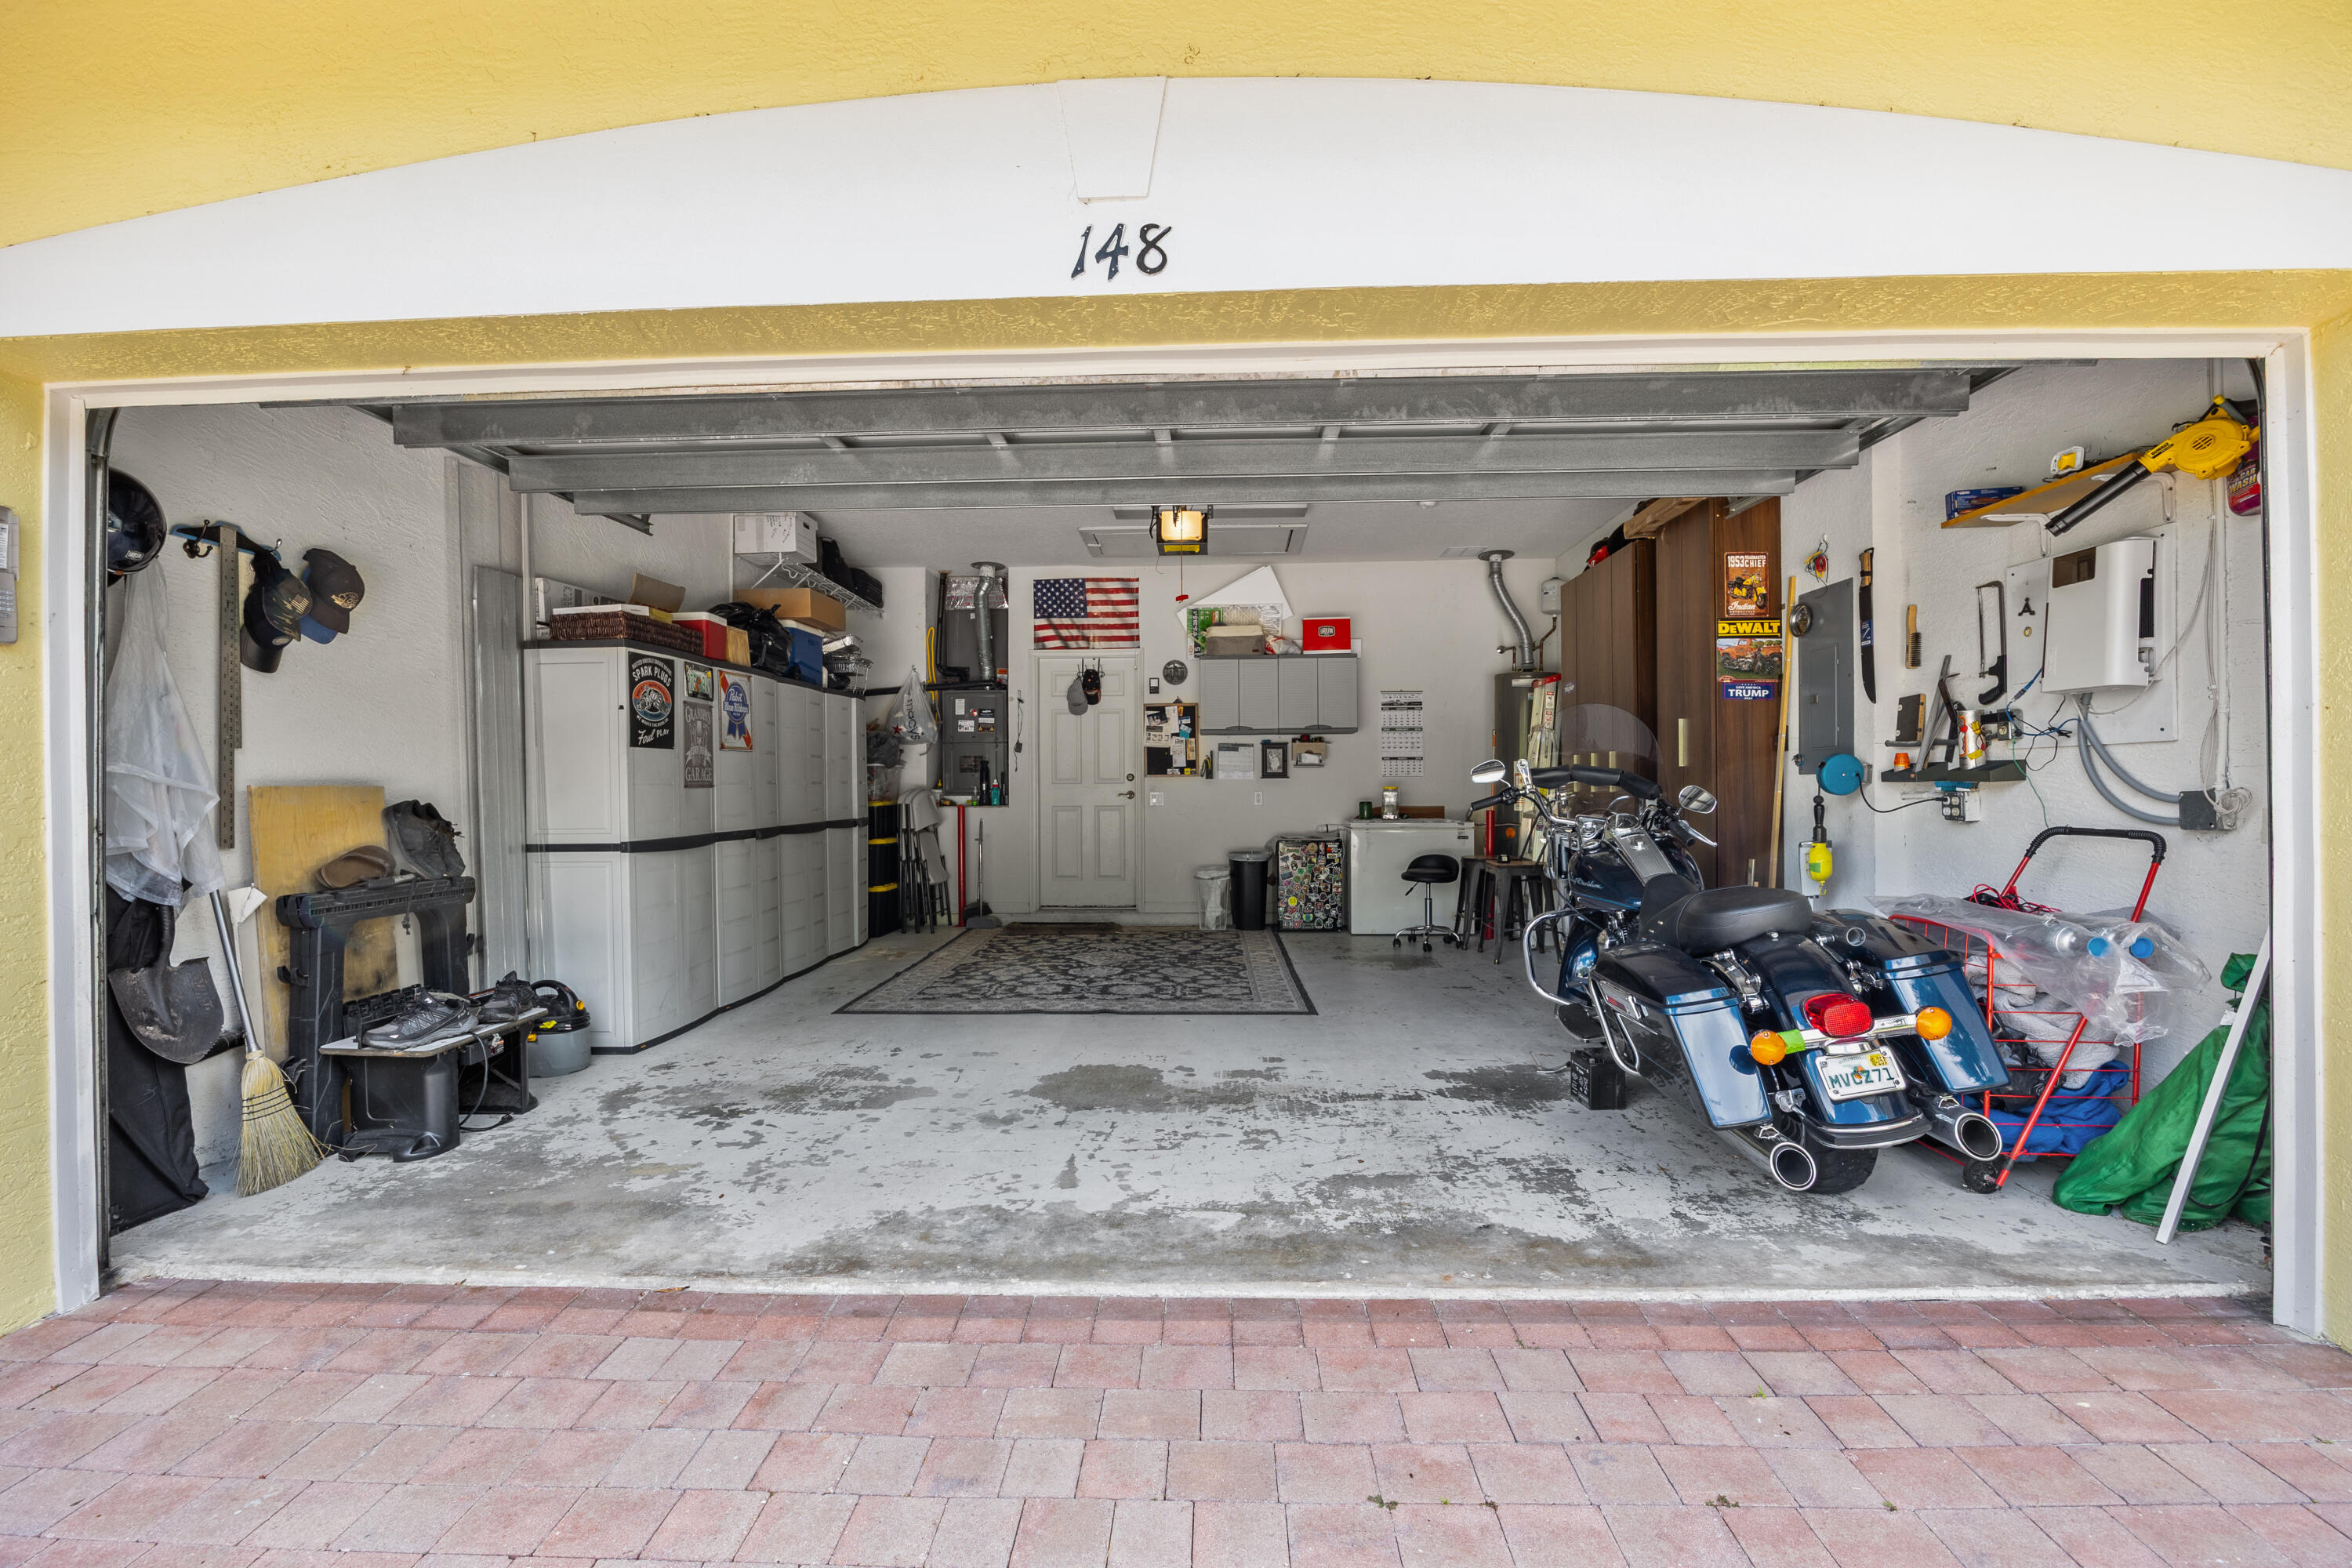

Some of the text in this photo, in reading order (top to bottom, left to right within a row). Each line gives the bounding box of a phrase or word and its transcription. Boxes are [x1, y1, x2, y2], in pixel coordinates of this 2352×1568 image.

[1071, 223, 1172, 281] 148
[2240, 467, 2256, 480] CAR
[2229, 474, 2257, 494] WASH
[1727, 555, 1744, 568] 1953
[1744, 559, 1766, 568] CHIEF
[1728, 601, 1755, 611] Indian
[1718, 622, 1780, 633] DEWALT
[632, 666, 652, 681] SPARK
[654, 666, 672, 687] PLUGS
[729, 688, 742, 702] Pabst
[656, 728, 670, 739] PLAY
[685, 766, 712, 782] GARAGE
